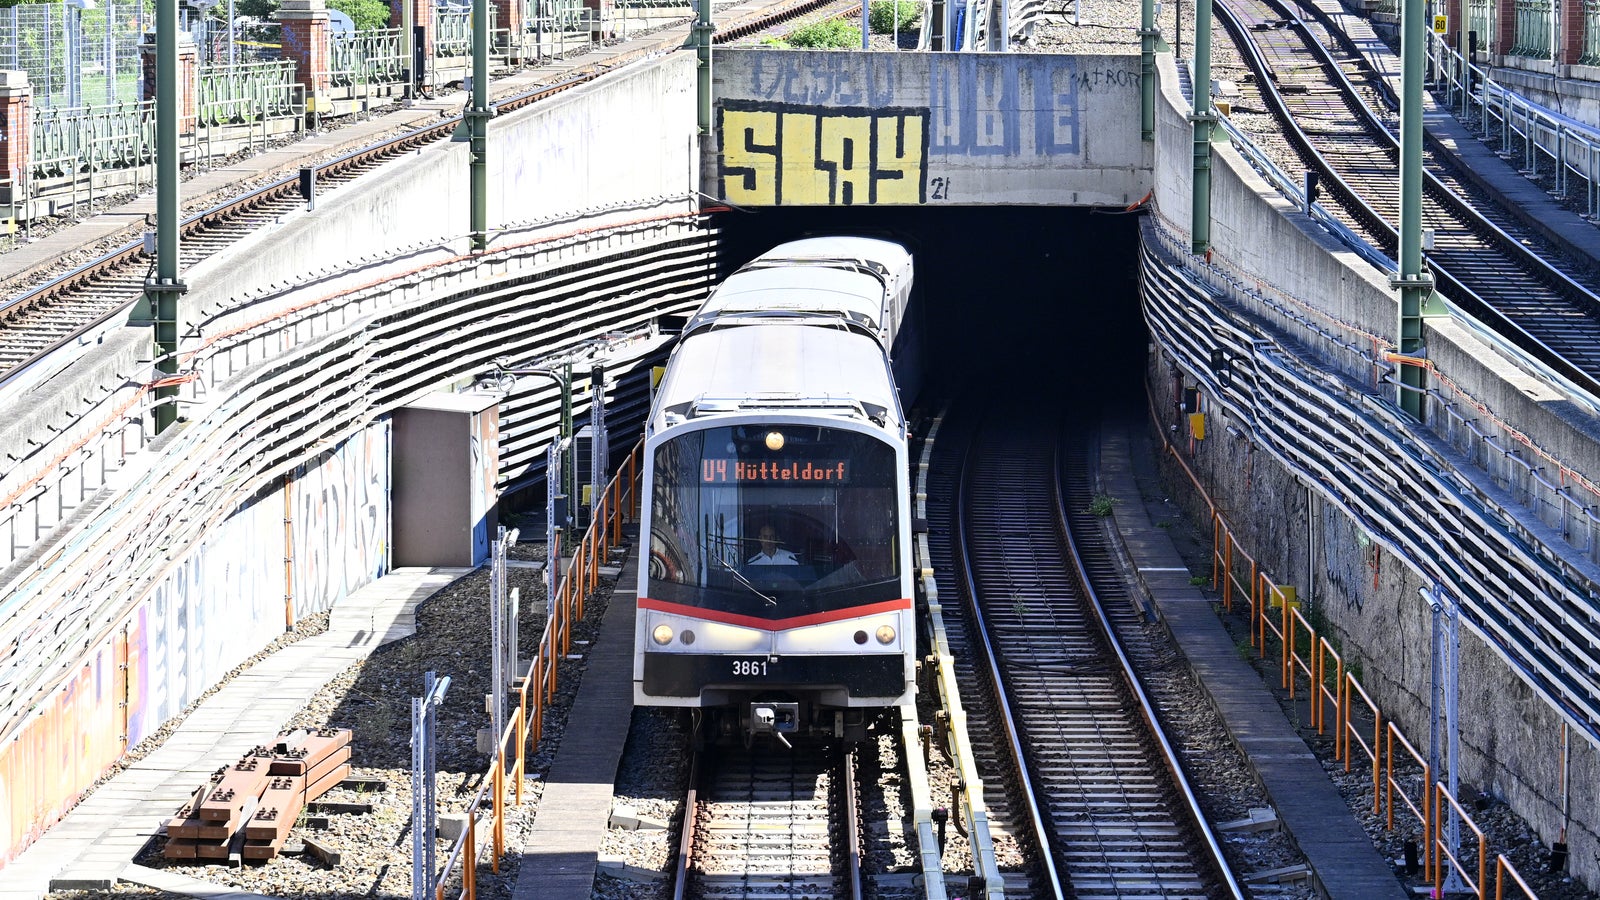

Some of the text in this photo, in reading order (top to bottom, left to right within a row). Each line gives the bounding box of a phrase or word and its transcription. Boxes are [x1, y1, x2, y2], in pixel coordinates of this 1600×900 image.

[1435, 20, 1446, 30] 60
[931, 176, 951, 200] 21
[703, 459, 845, 482] U4 Hütteldorf
[732, 660, 767, 676] 3861
